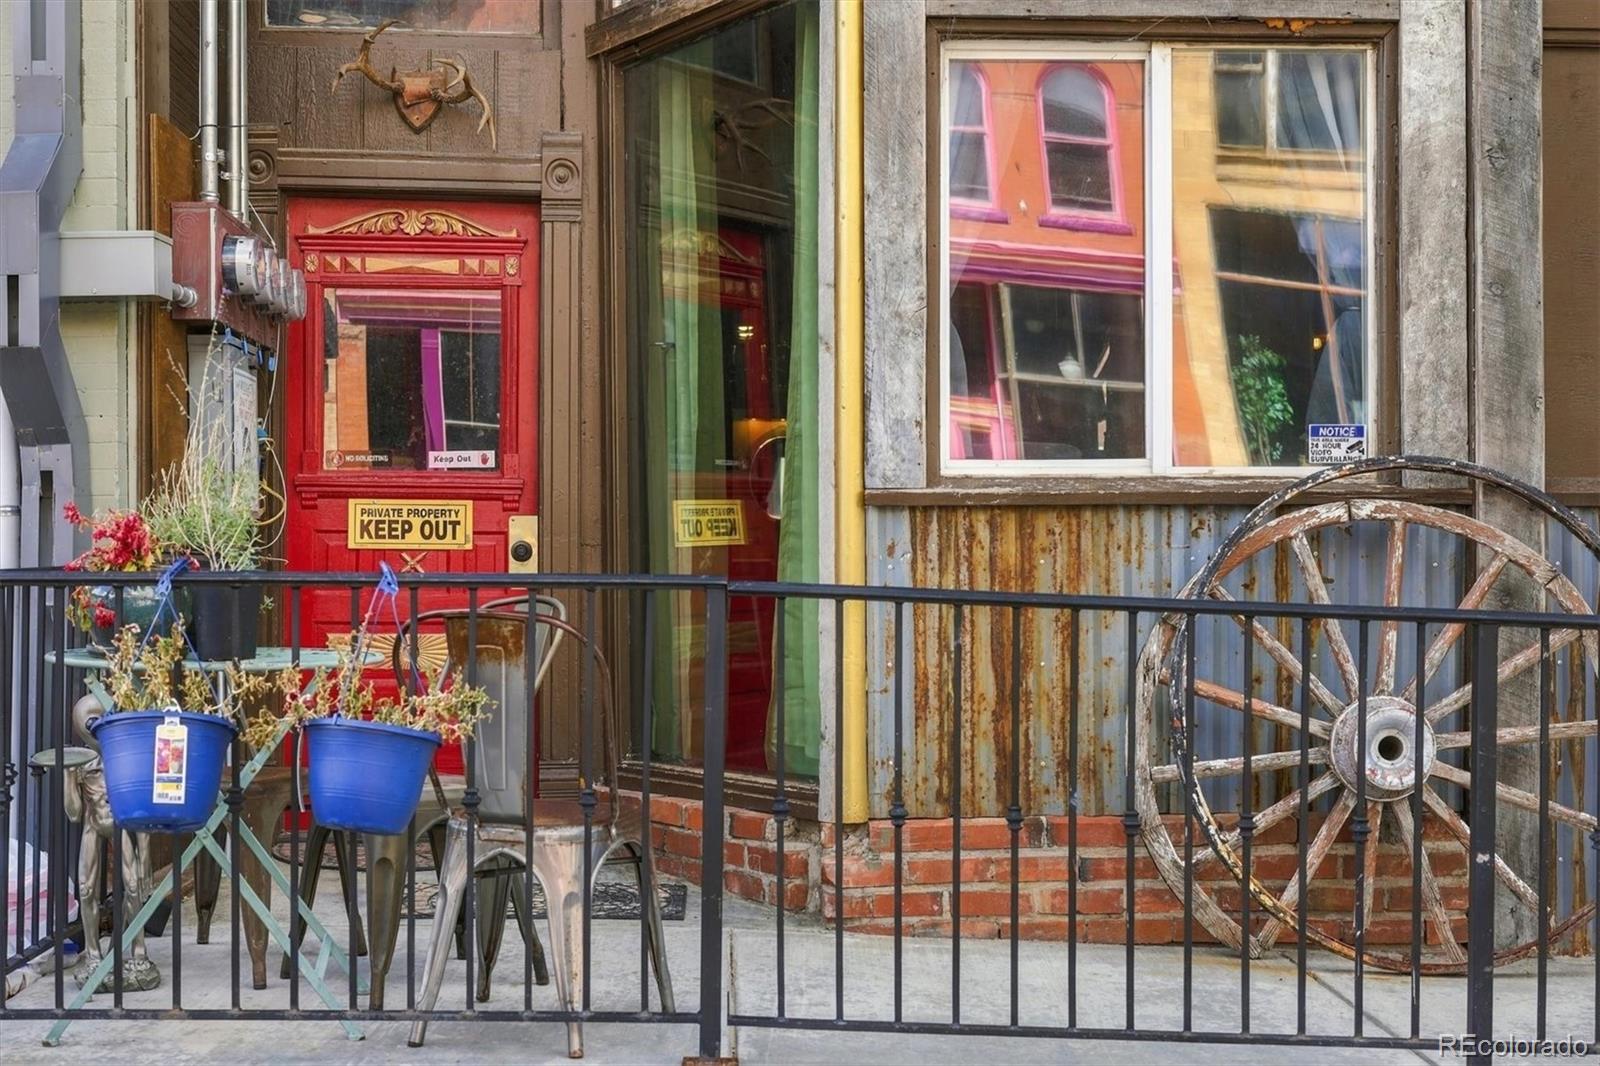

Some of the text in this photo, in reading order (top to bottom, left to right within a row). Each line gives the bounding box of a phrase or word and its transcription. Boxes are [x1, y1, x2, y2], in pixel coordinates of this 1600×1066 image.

[1319, 427, 1356, 436] NOTICE
[434, 455, 471, 463] Keep Out
[360, 508, 460, 518] PRIVATE PROPERTY
[359, 519, 461, 541] KEEP OUT
